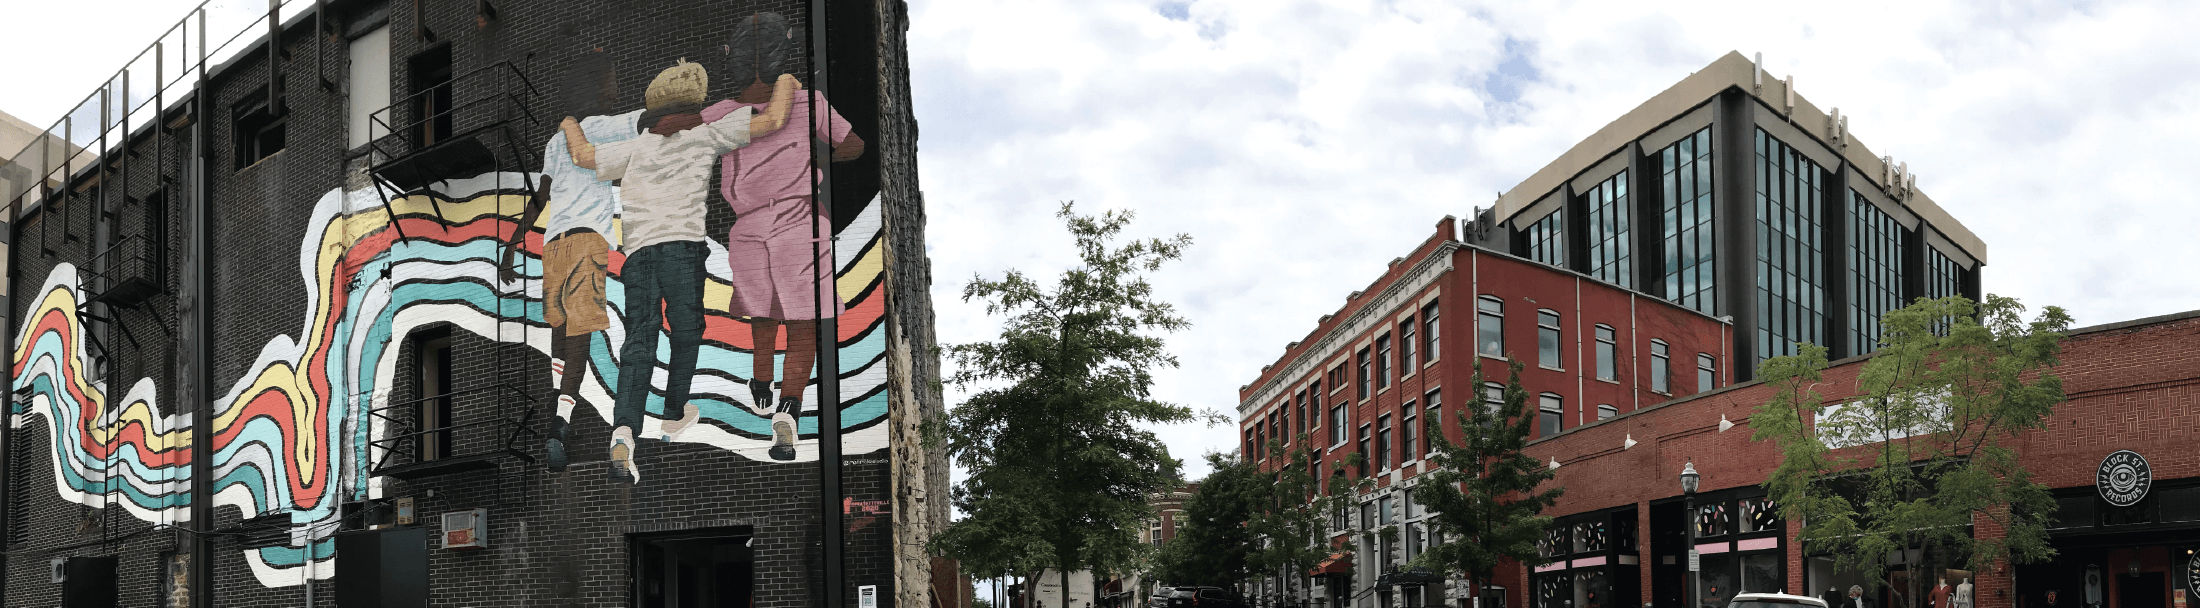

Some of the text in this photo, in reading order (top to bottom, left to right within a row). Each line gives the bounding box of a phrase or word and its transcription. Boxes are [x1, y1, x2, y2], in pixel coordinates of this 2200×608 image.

[2102, 454, 2143, 473] BLOCK ST.
[2105, 487, 2143, 502] RECORDS
